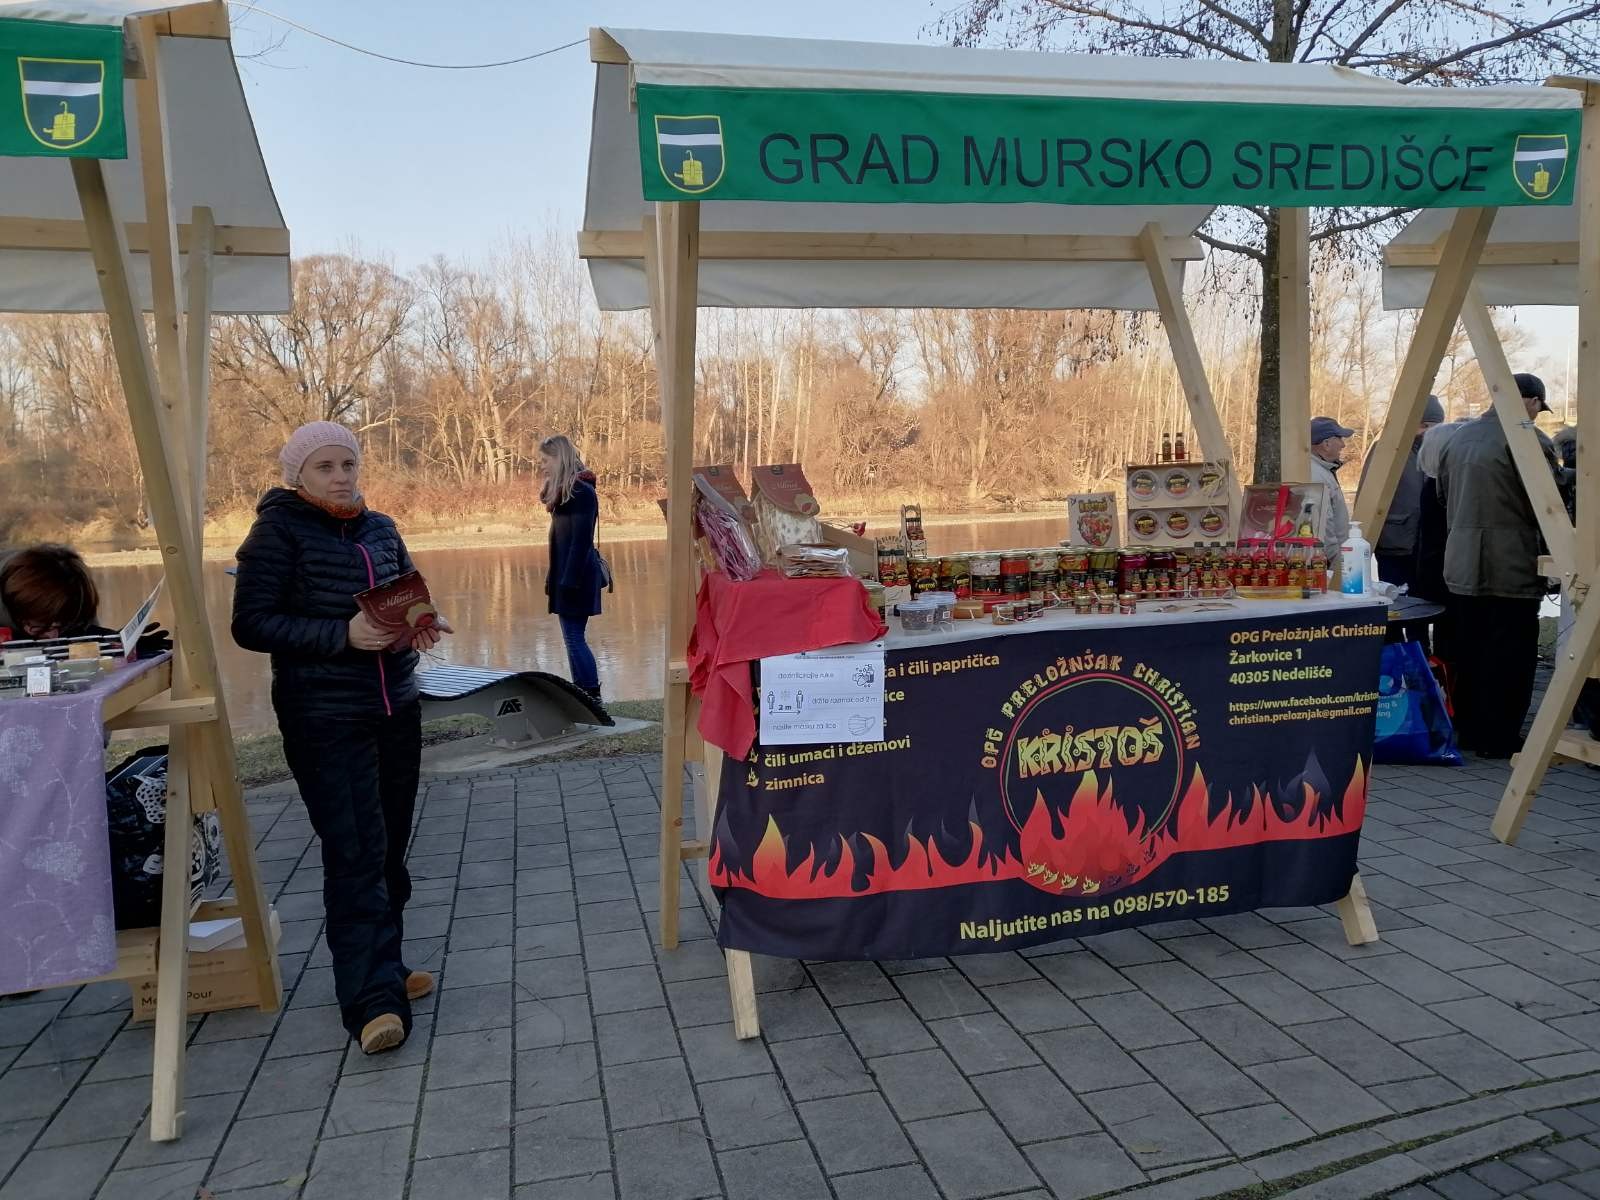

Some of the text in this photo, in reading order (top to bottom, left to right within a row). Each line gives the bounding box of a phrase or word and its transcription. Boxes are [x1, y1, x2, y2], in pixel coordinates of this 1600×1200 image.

[758, 131, 1494, 192] GRAD MURSKO SREDIŠĆE
[1230, 623, 1387, 645] OPG Preložnjak Christian
[900, 663, 905, 676] i
[907, 660, 929, 676] čili
[932, 654, 1000, 675] papričica
[1229, 648, 1303, 665] Žarkovice 1
[1229, 665, 1333, 685] 40305 Nedelišće
[884, 689, 905, 703] ice
[980, 648, 1201, 769] OPG PRELOŽNJAK CHRISTIAN
[1229, 705, 1372, 726] christian.preloznjak@gmail.com
[764, 735, 911, 768] čili umaci i džemovi
[1017, 715, 1164, 779] KRISTOŠ
[765, 772, 825, 791] zimnica
[960, 885, 1230, 942] Naljutite nas na 098/570-185
[186, 991, 212, 1000] Pour
